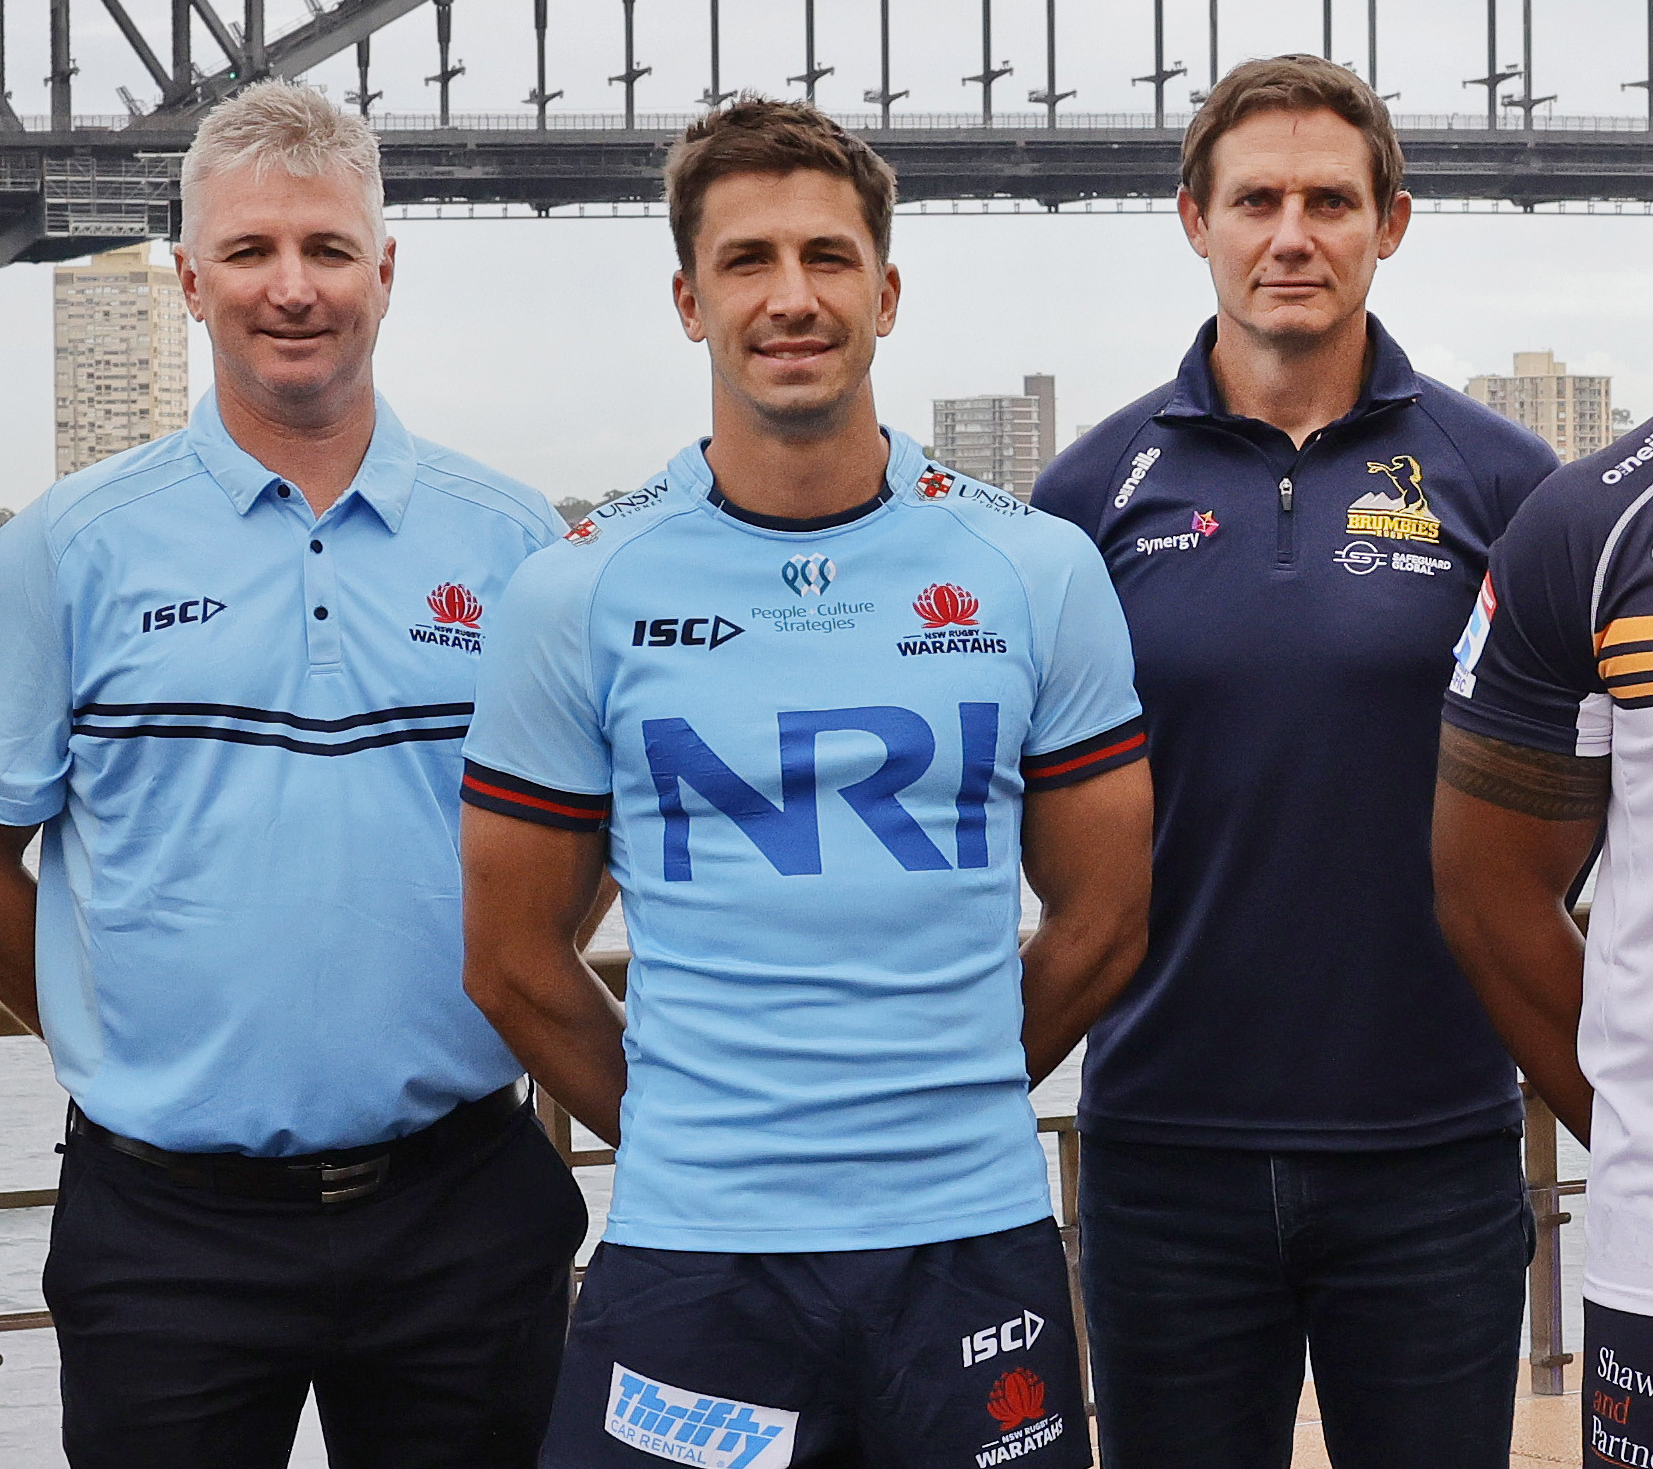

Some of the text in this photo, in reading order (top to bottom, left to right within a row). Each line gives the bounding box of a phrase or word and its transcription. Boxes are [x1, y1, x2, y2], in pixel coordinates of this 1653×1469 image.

[596, 478, 668, 518] UNSW
[958, 484, 1038, 516] UNSW
[1347, 514, 1441, 539] BRUMBIES
[1136, 531, 1200, 556] Synergy
[1391, 552, 1452, 571] SAFEGUARD
[1391, 561, 1435, 576] GLOBAL
[143, 600, 202, 633] ISC
[751, 605, 807, 621] People
[817, 601, 875, 617] Culture
[774, 616, 856, 633] Strategies
[409, 628, 483, 655] WARATA
[632, 617, 707, 647] ISC
[924, 629, 980, 640] NSW RUGBY
[896, 638, 1007, 657] WARATAHS
[641, 702, 1000, 882] NRI
[962, 1316, 1023, 1367] ISC
[1594, 1389, 1631, 1426] and
[610, 1419, 707, 1465] CAR RENTAL
[975, 1417, 1063, 1469] WARATAHS
[1002, 1418, 1049, 1444] NSW RUGBY
